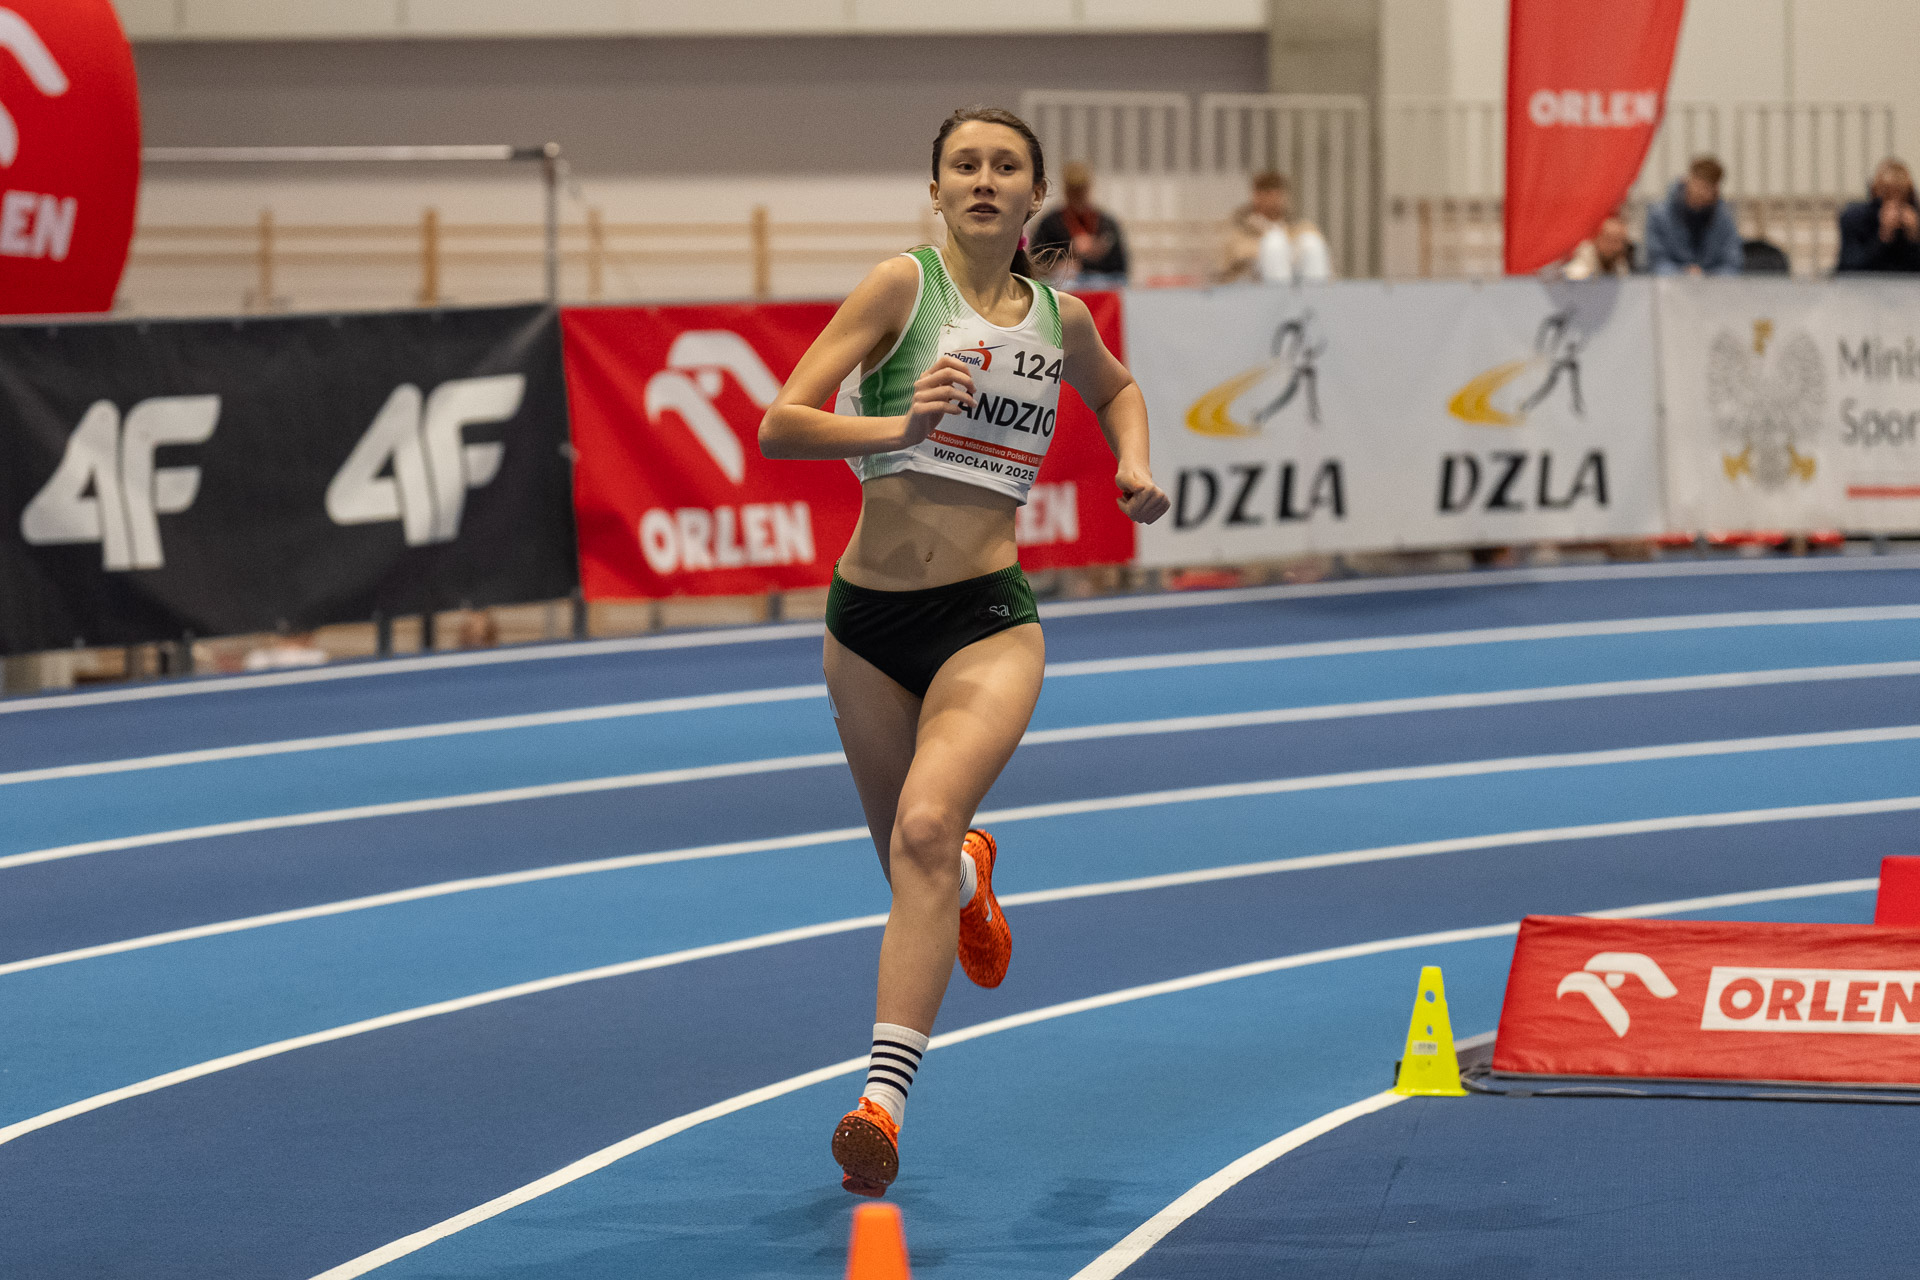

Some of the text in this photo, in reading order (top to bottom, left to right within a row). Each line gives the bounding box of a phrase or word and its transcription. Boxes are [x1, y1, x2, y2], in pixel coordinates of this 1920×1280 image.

[1529, 89, 1658, 127] ORLEN
[1013, 350, 1062, 384] 124
[957, 391, 1056, 438] ANDZIO
[20, 395, 221, 571] 4F
[325, 374, 526, 545] 4F
[933, 446, 1035, 481] WROCŁAW 2025
[1437, 448, 1610, 514] DZLA
[1172, 458, 1347, 530] DZLA
[639, 500, 816, 575] ORLEN
[1718, 976, 1920, 1023] ORLEN
